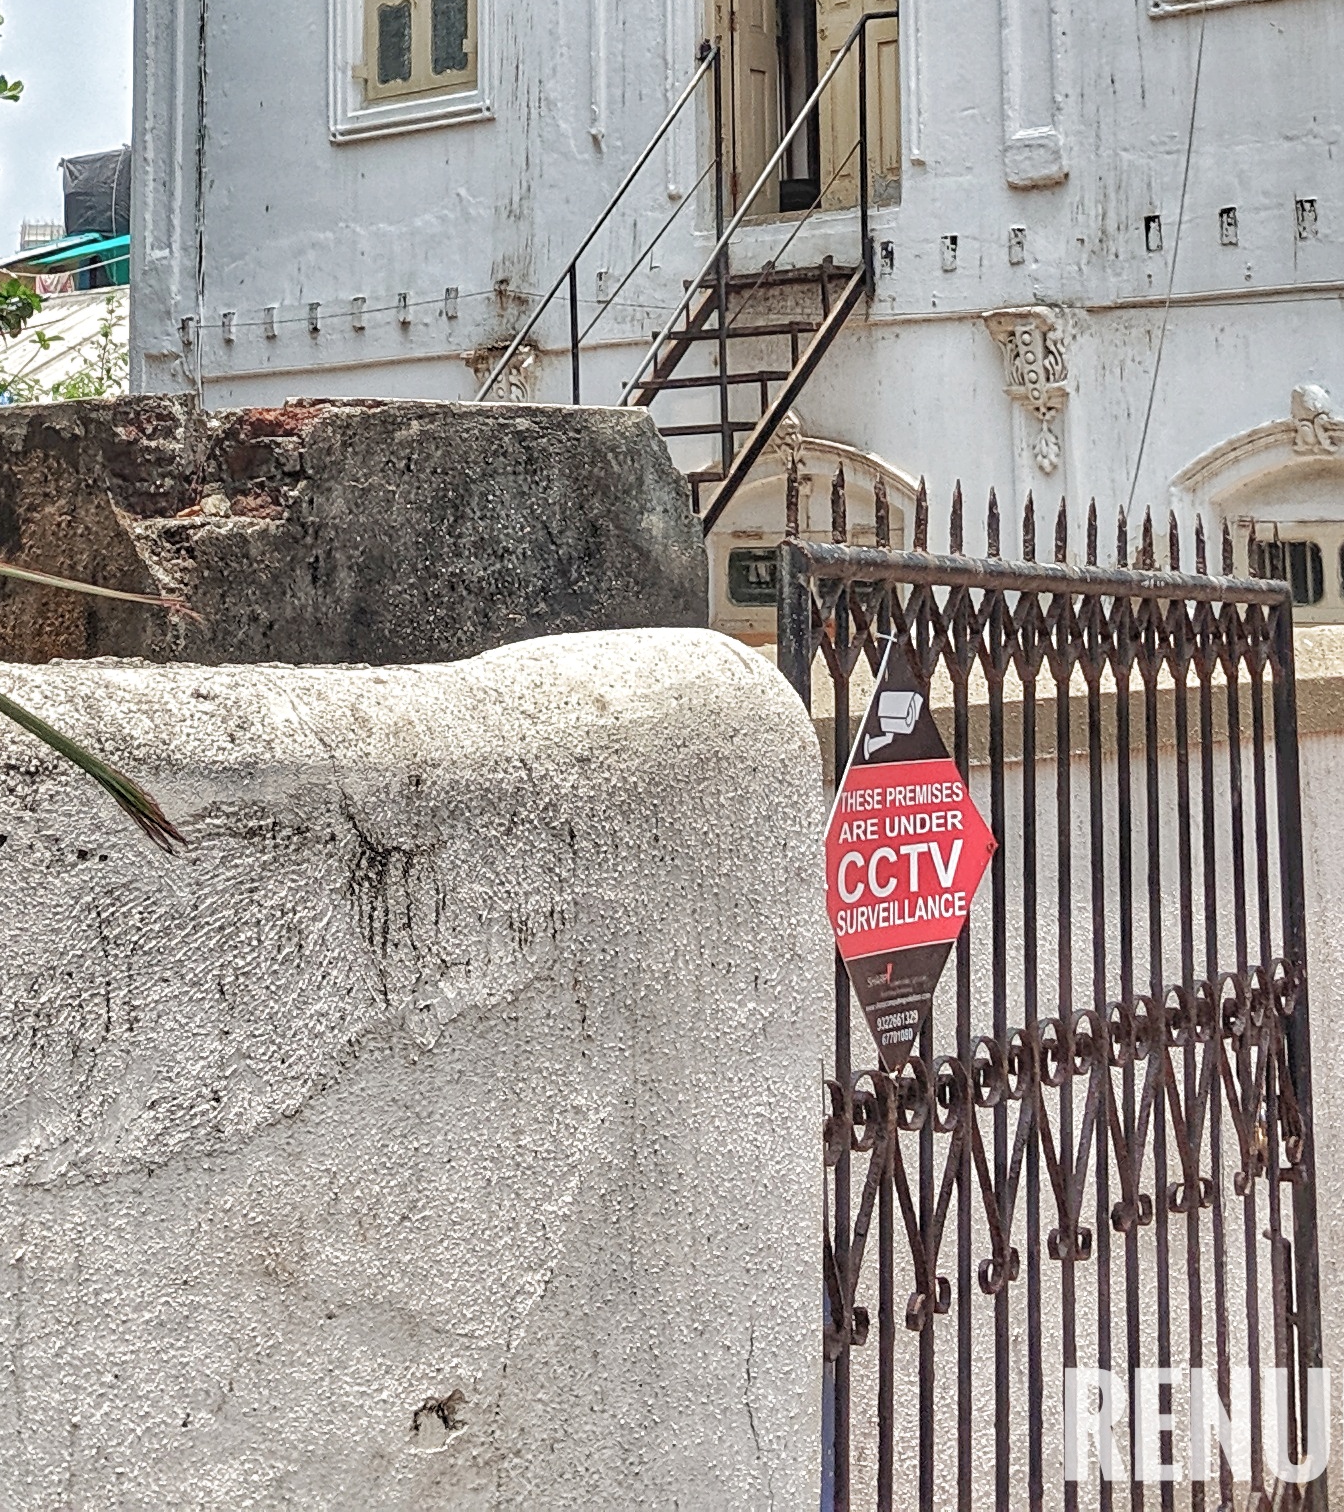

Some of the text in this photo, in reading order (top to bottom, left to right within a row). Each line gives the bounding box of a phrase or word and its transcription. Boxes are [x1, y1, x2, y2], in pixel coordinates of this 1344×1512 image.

[841, 782, 963, 813] THESE PREMISES
[839, 810, 963, 844] ARE UNDER
[837, 839, 963, 903] CCTV
[836, 892, 967, 936] SURVEILLANCE
